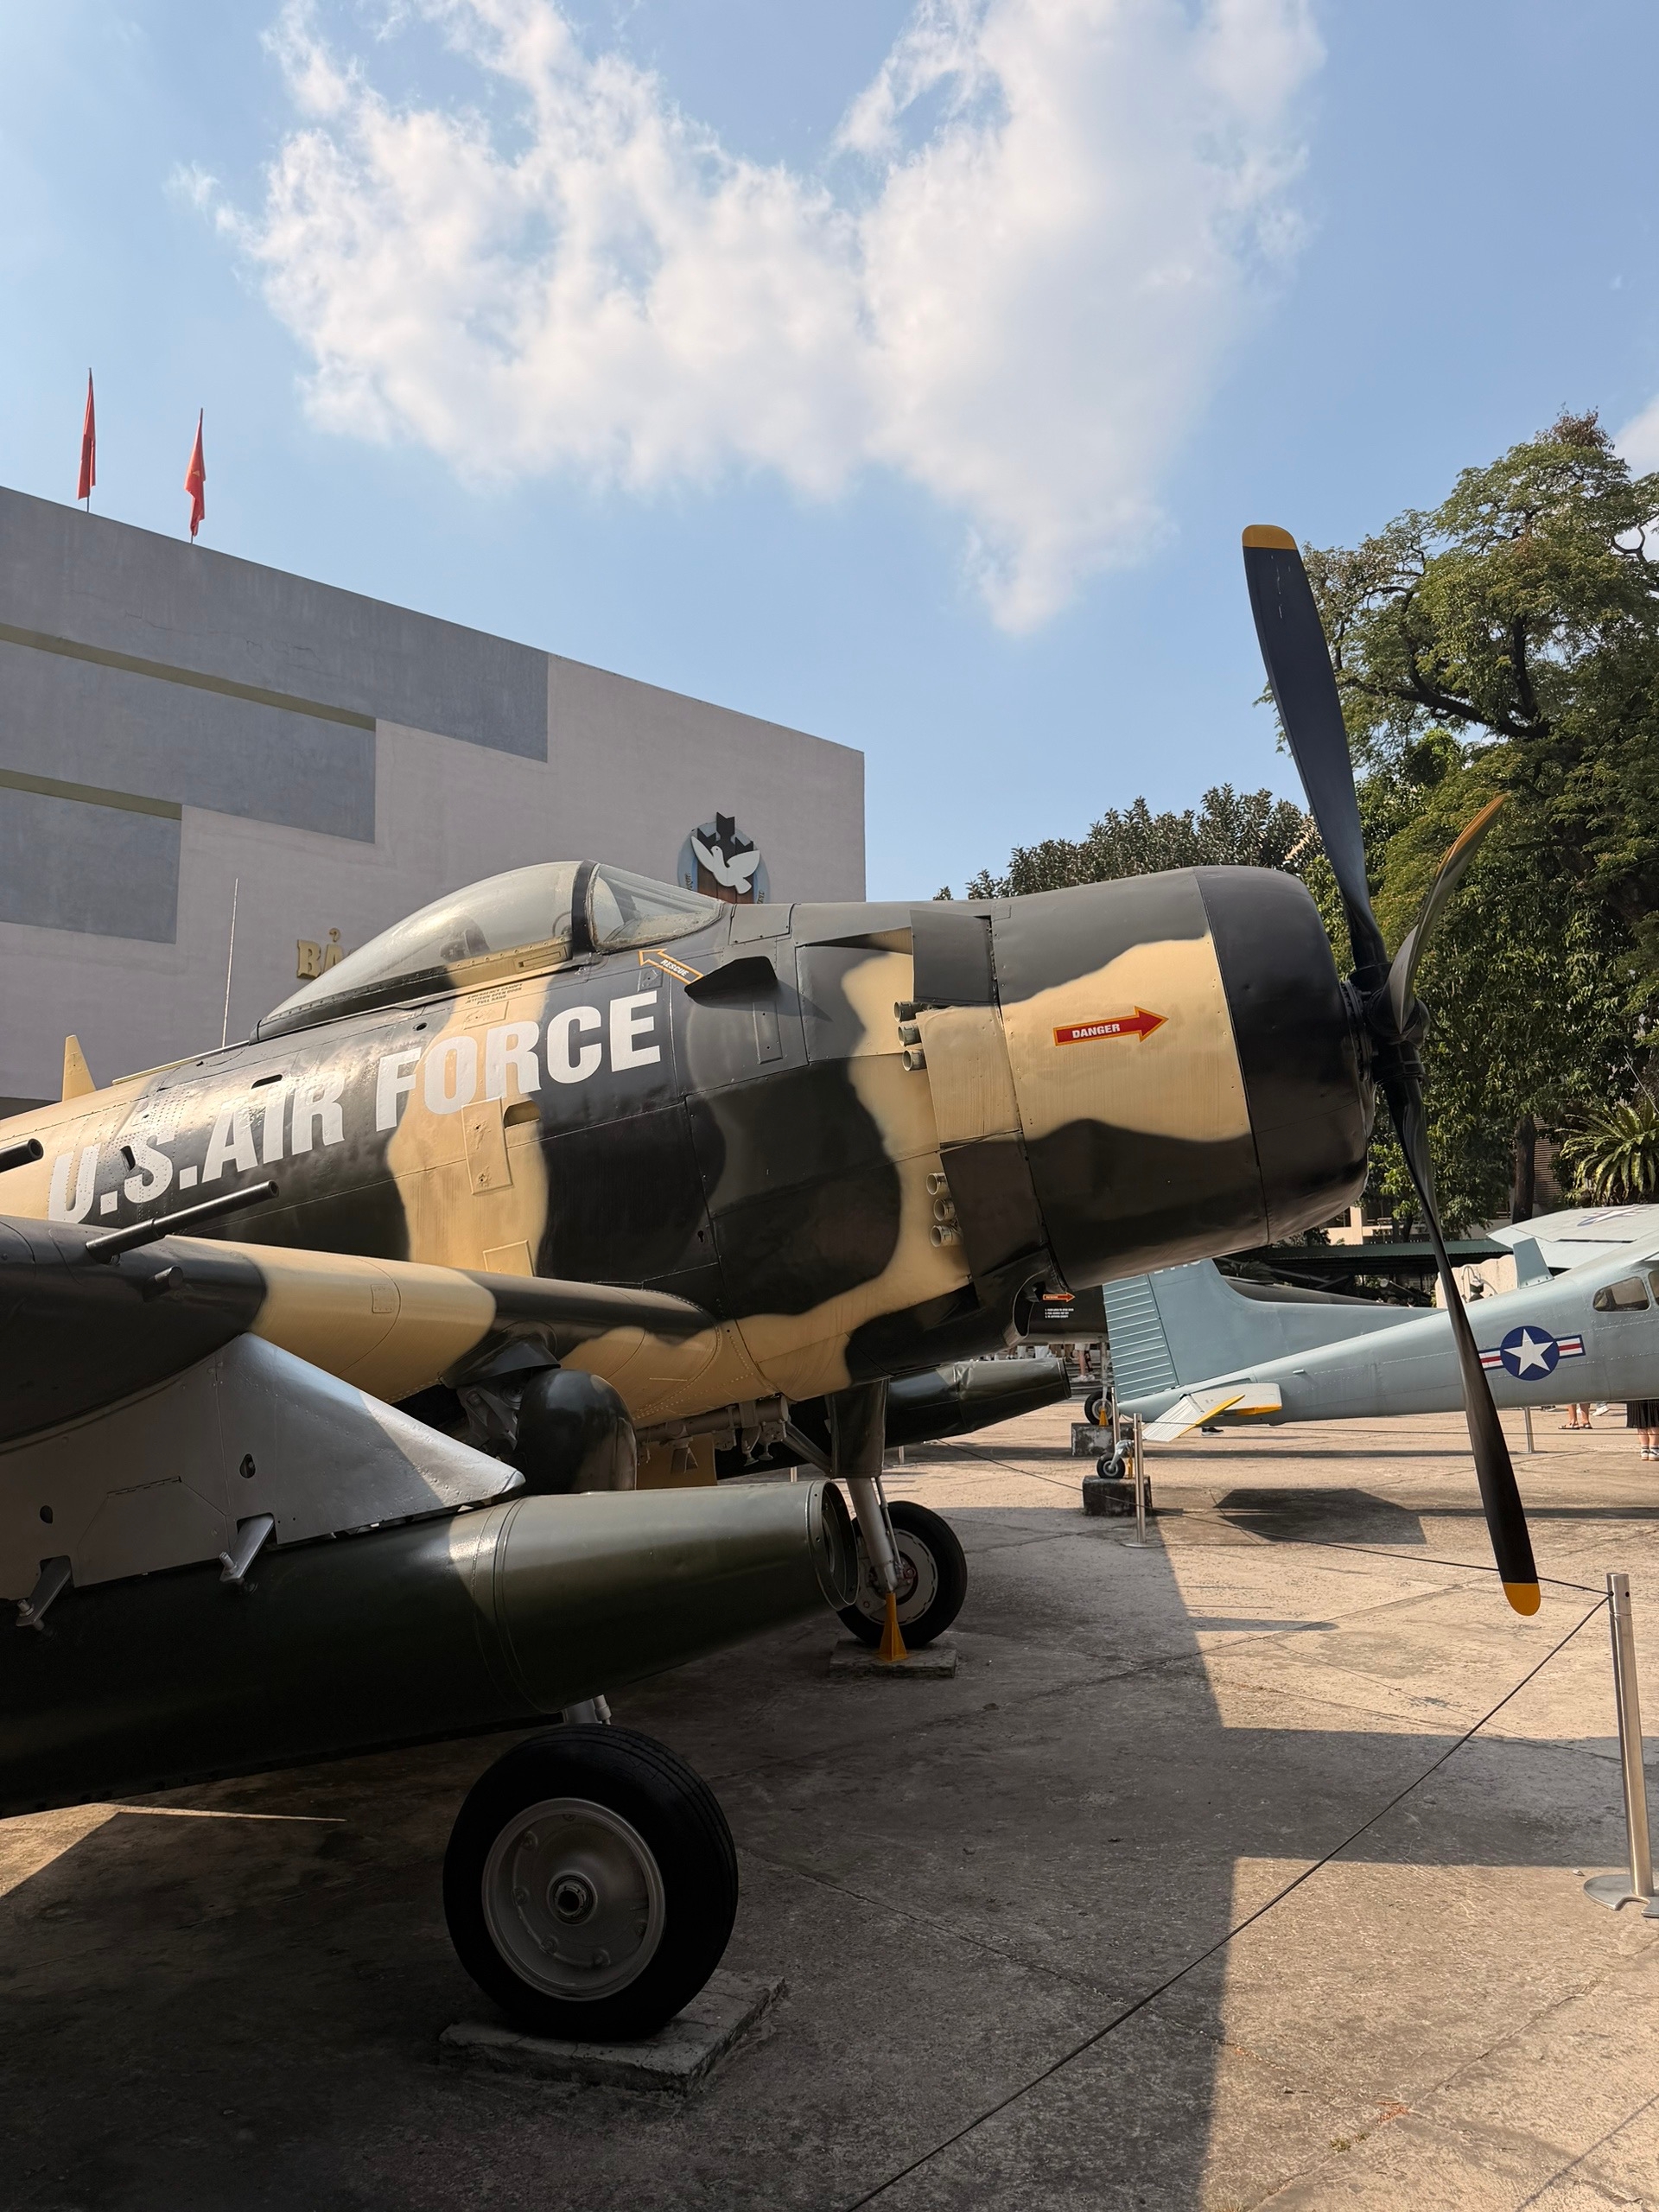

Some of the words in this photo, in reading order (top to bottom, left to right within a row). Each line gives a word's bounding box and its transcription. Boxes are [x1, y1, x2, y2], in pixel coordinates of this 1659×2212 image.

[296, 927, 356, 980] BẢ
[659, 958, 690, 977] RESCUE
[1071, 1023, 1121, 1039] DANGER
[375, 990, 661, 1132] FORCE
